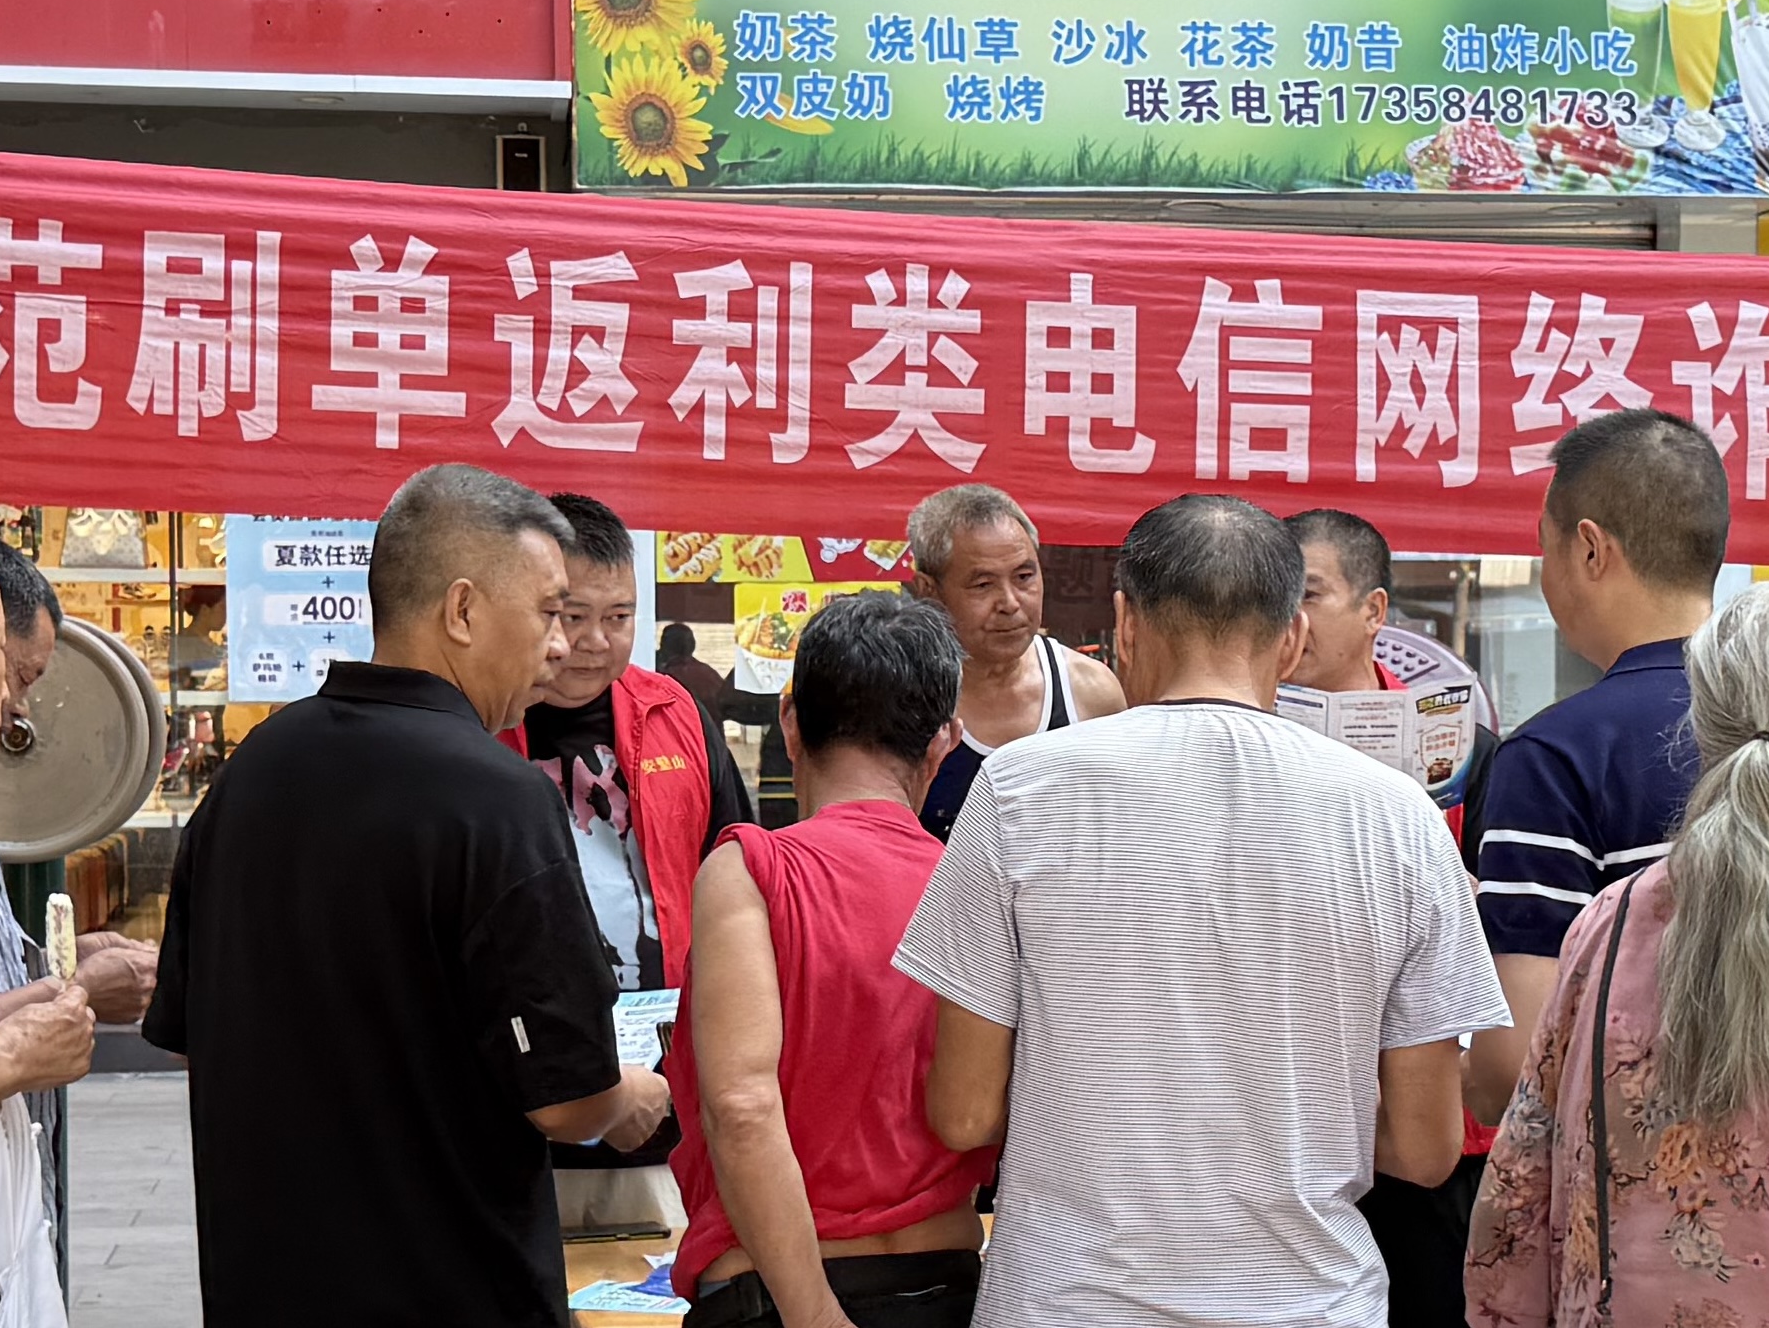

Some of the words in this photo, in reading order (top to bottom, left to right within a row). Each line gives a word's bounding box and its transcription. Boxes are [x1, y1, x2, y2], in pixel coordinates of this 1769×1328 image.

[733, 11, 836, 62] 奶茶
[867, 14, 1022, 65] 烧仙草
[1050, 18, 1149, 66] 沙冰
[1180, 21, 1276, 70] 花茶
[1306, 22, 1403, 72] 奶昔
[1442, 26, 1638, 76] 油炸小吃
[735, 72, 892, 121] 双皮奶
[946, 74, 1046, 124] 烧烤
[1124, 78, 1638, 129] 联系电话17358481733
[274, 544, 372, 567] 夏款任选
[302, 596, 356, 621] 400
